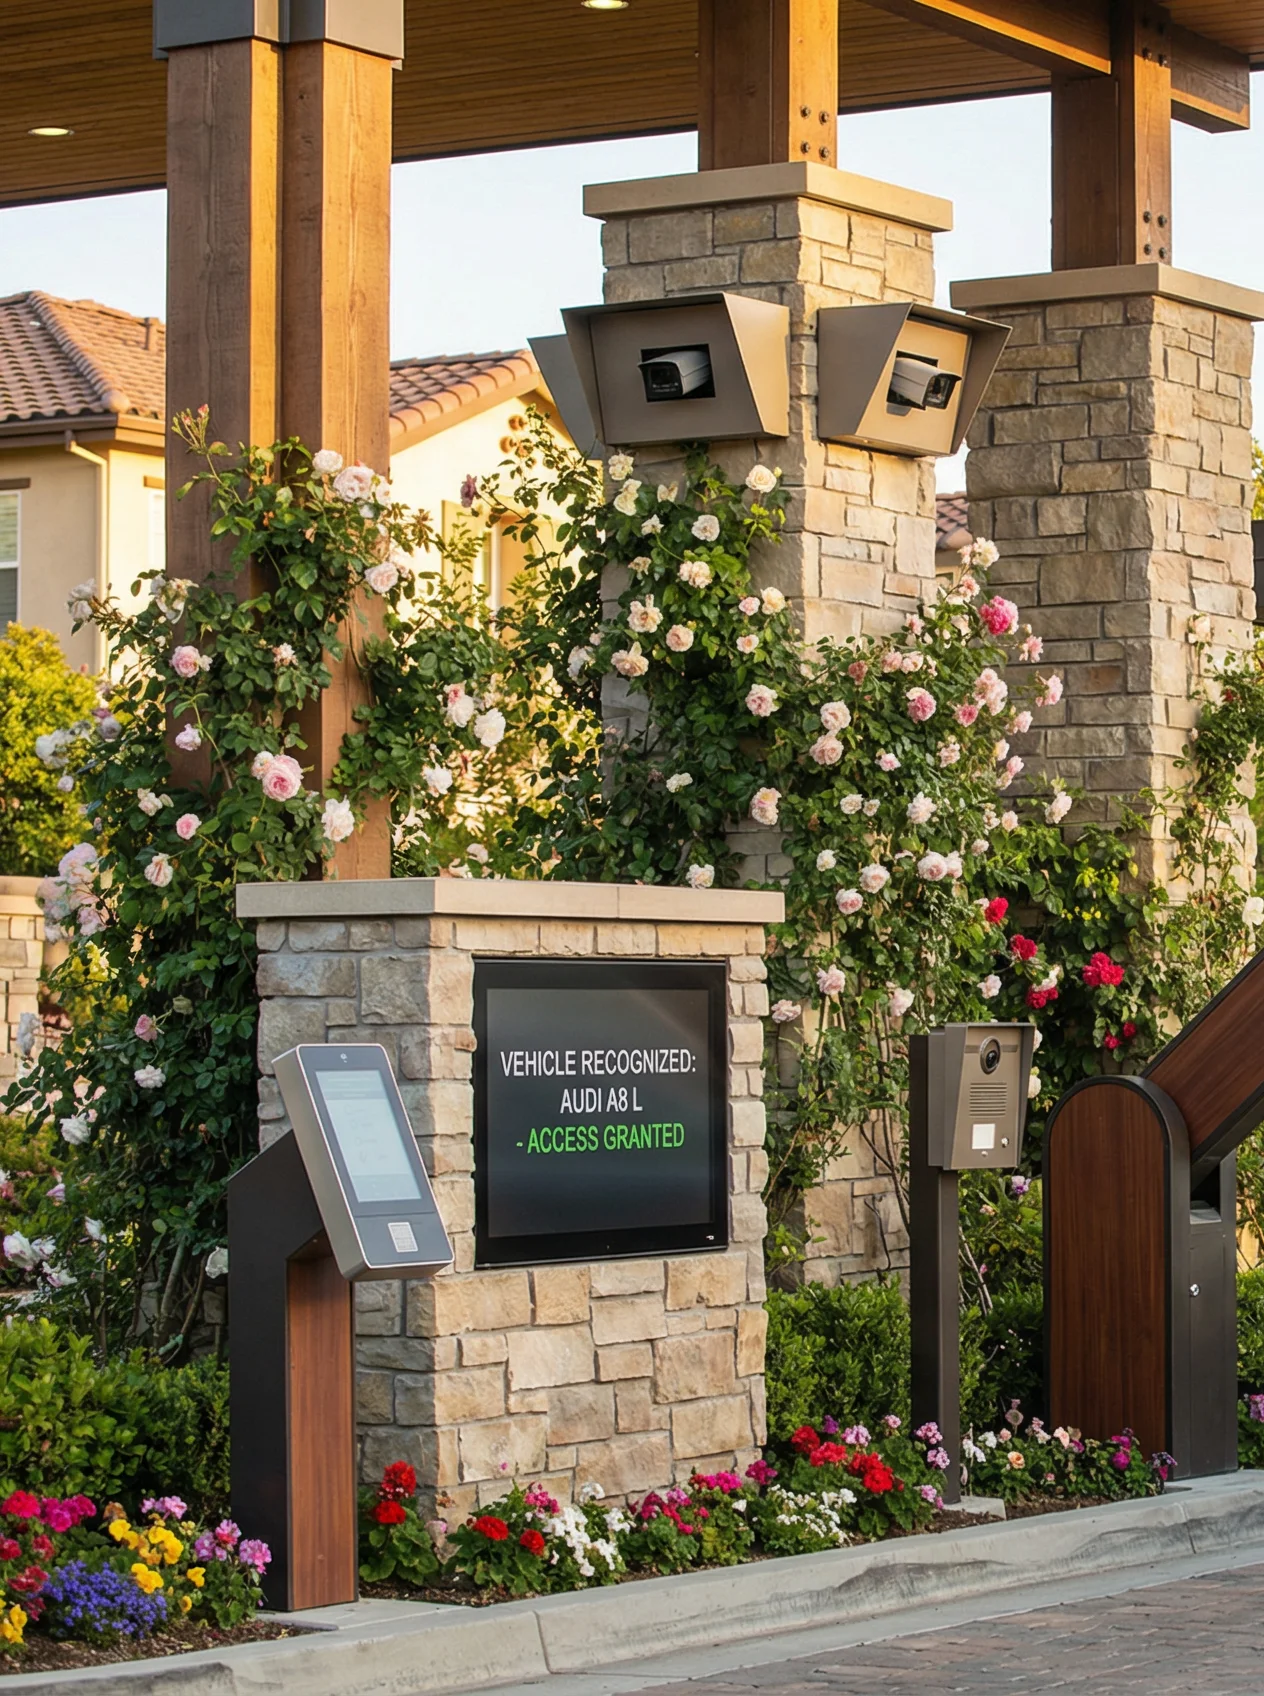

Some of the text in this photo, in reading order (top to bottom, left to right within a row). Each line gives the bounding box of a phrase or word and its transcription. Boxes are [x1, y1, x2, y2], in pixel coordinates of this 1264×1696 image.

[500, 1049, 697, 1077] VEHICLE RECOGNIZED:
[560, 1086, 643, 1114] AUDI A8 L
[527, 1126, 599, 1154] ACCESS
[603, 1122, 686, 1150] GRANTED
